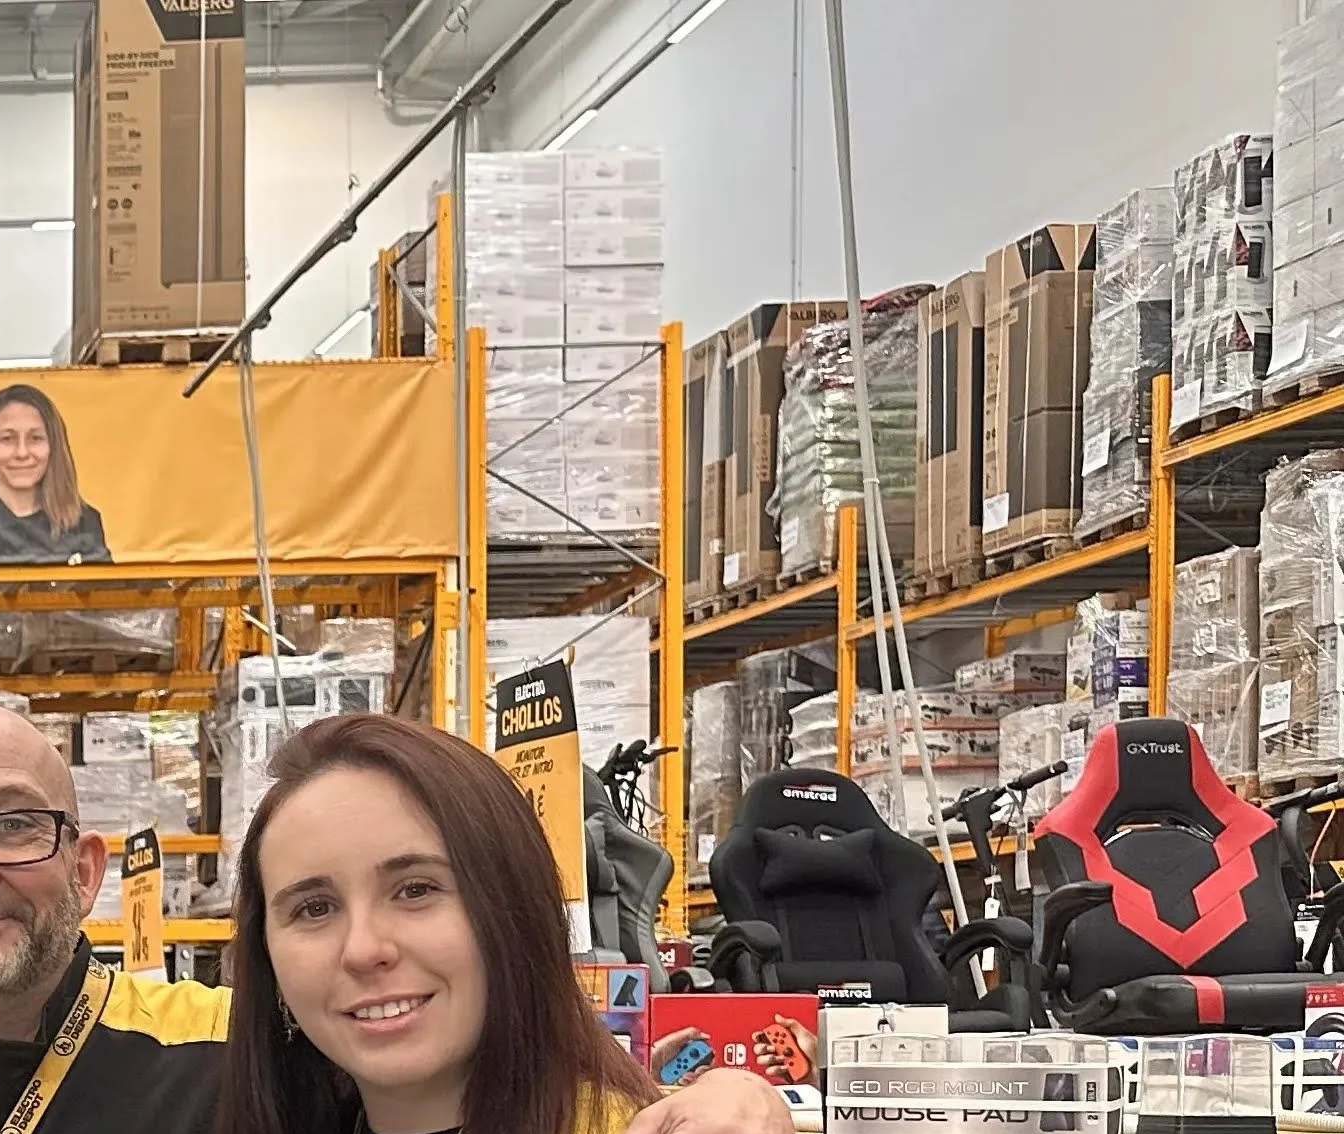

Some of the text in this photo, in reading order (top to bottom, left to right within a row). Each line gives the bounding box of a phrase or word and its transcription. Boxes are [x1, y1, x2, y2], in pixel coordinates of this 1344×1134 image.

[514, 679, 546, 703] ELECTRO
[501, 695, 563, 737] CHOLLOS
[782, 787, 837, 802] amstrad
[817, 985, 872, 999] amstrad
[62, 993, 90, 1036] ELECTRO
[71, 1007, 94, 1041] DEPOT
[834, 1080, 1029, 1095] LED RGB MOUNT
[10, 1079, 42, 1127] ELECTRO
[18, 1092, 45, 1132] DEPOT
[834, 1106, 1029, 1124] MOUSE PAD
